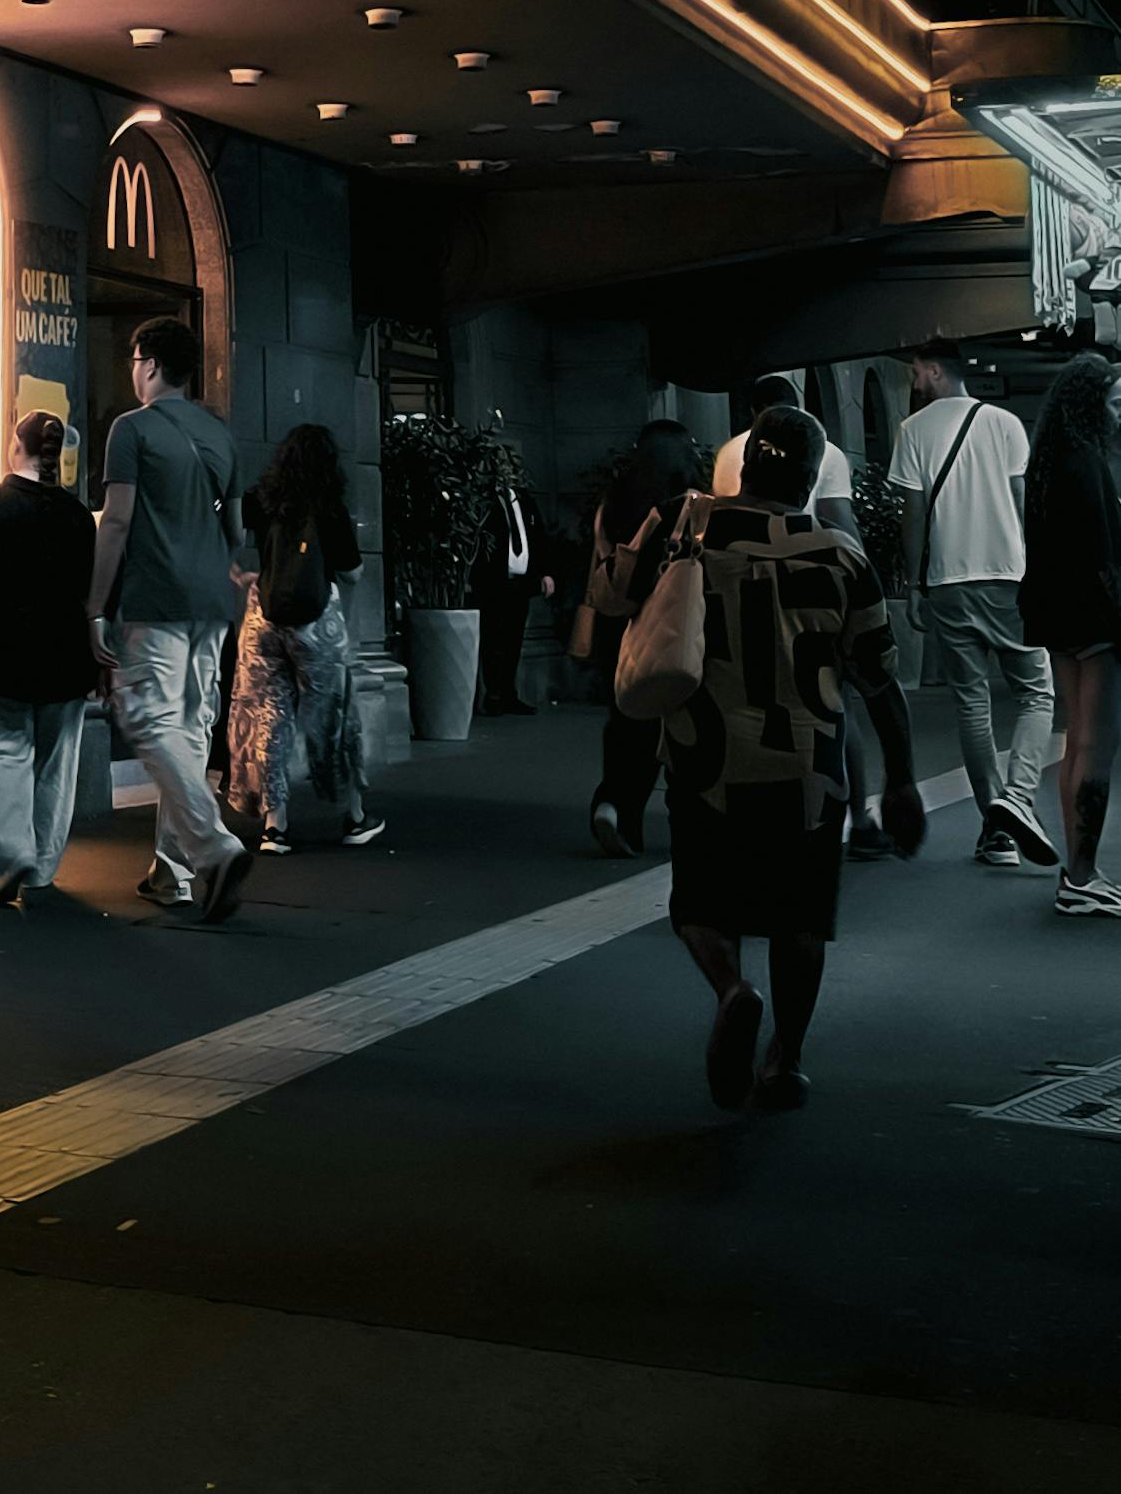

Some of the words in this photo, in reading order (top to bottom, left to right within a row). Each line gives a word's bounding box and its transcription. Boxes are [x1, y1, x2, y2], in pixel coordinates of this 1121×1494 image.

[21, 267, 50, 306] QUE
[50, 272, 72, 306] TAL
[16, 310, 37, 344] UM
[38, 307, 78, 348] CAFÉ?
